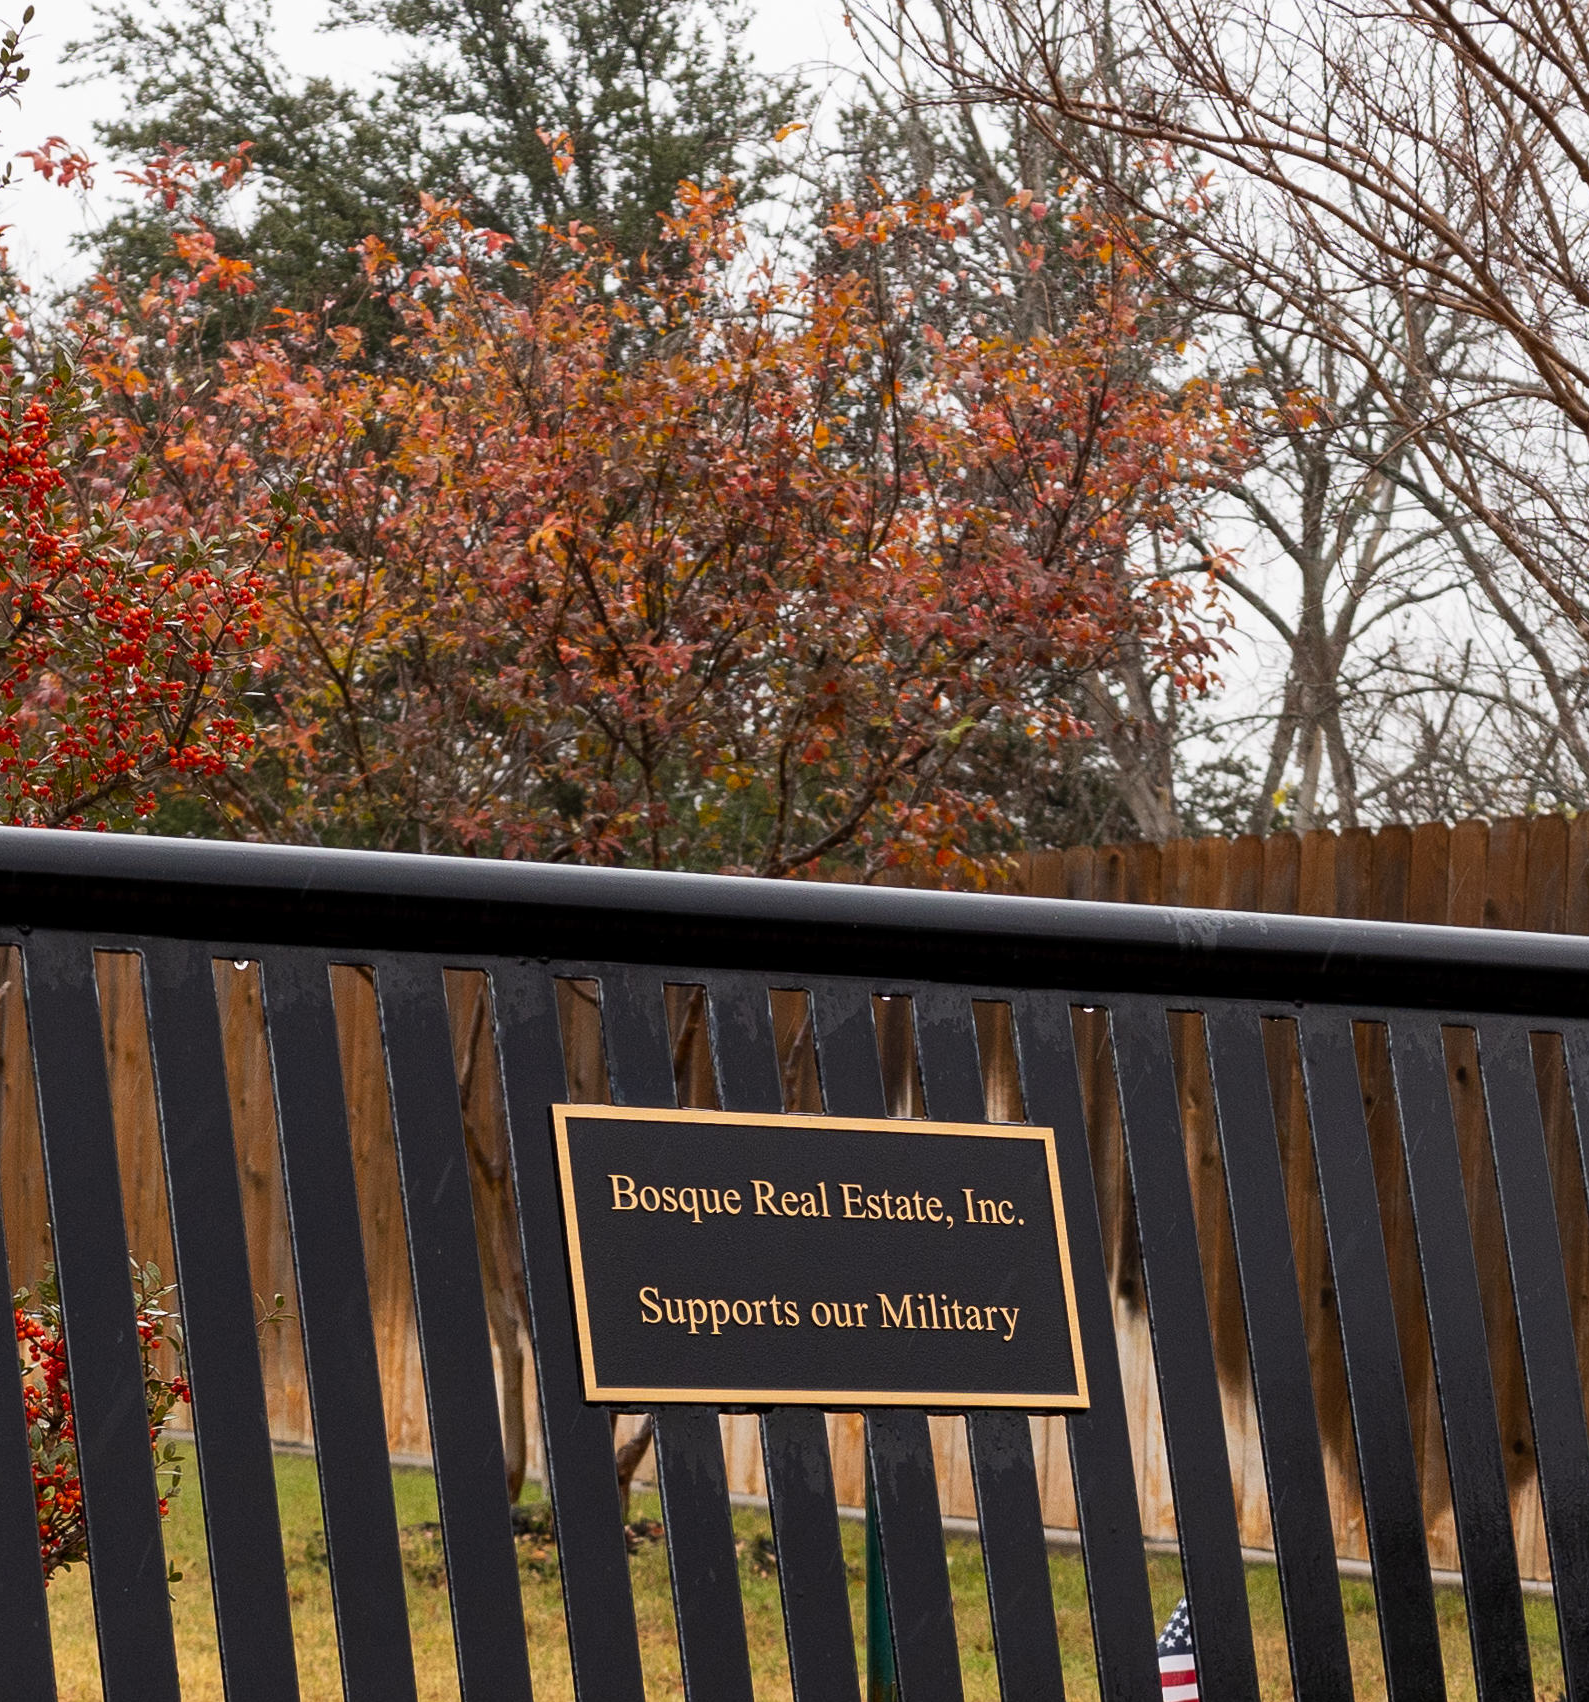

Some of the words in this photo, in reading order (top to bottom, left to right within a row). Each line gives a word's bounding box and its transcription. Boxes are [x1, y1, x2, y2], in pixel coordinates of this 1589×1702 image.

[608, 1174, 742, 1224] Bosque
[751, 1180, 831, 1218] Real
[839, 1184, 954, 1229] Estate,
[962, 1189, 1024, 1226] Inc.
[640, 1287, 799, 1335] Supports
[812, 1301, 869, 1328] our
[877, 1293, 1020, 1341] Military
